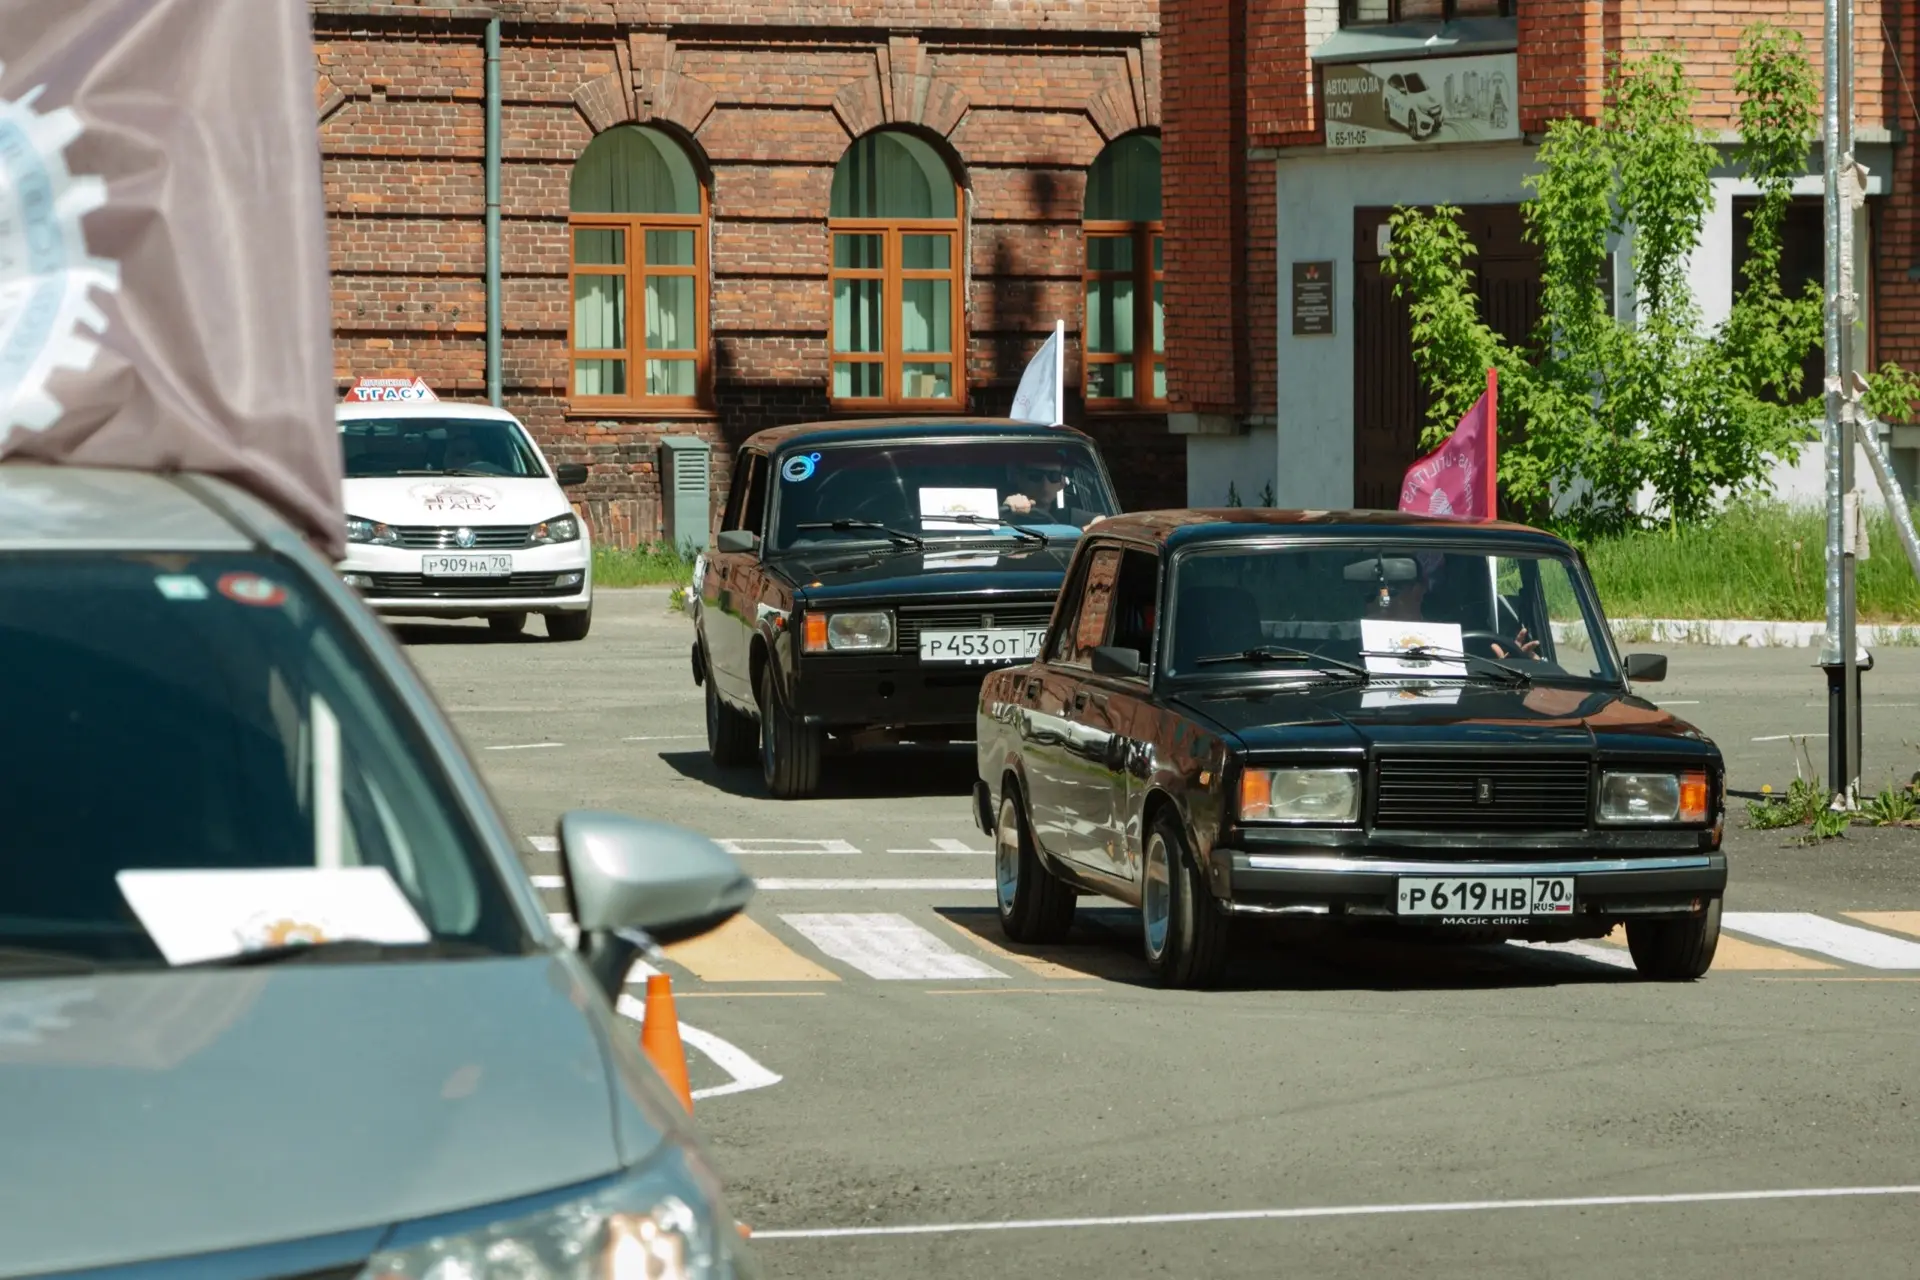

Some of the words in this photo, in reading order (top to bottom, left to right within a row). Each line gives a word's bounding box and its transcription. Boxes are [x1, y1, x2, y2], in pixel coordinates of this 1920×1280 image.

[1325, 77, 1380, 95] АВТОШКОЛА
[1327, 102, 1353, 119] ТГАСУ
[1335, 130, 1367, 146] 65-11-05
[357, 389, 424, 399] ТГАСУ
[429, 558, 488, 572] Р909НА
[492, 557, 506, 568] 70
[930, 635, 1020, 656] Р453ОТ
[1409, 882, 1527, 911] Р619НВ
[1536, 880, 1565, 902] 70
[1533, 903, 1555, 912] RUS
[1442, 917, 1488, 925] MAGic
[1492, 917, 1529, 925] clinic
